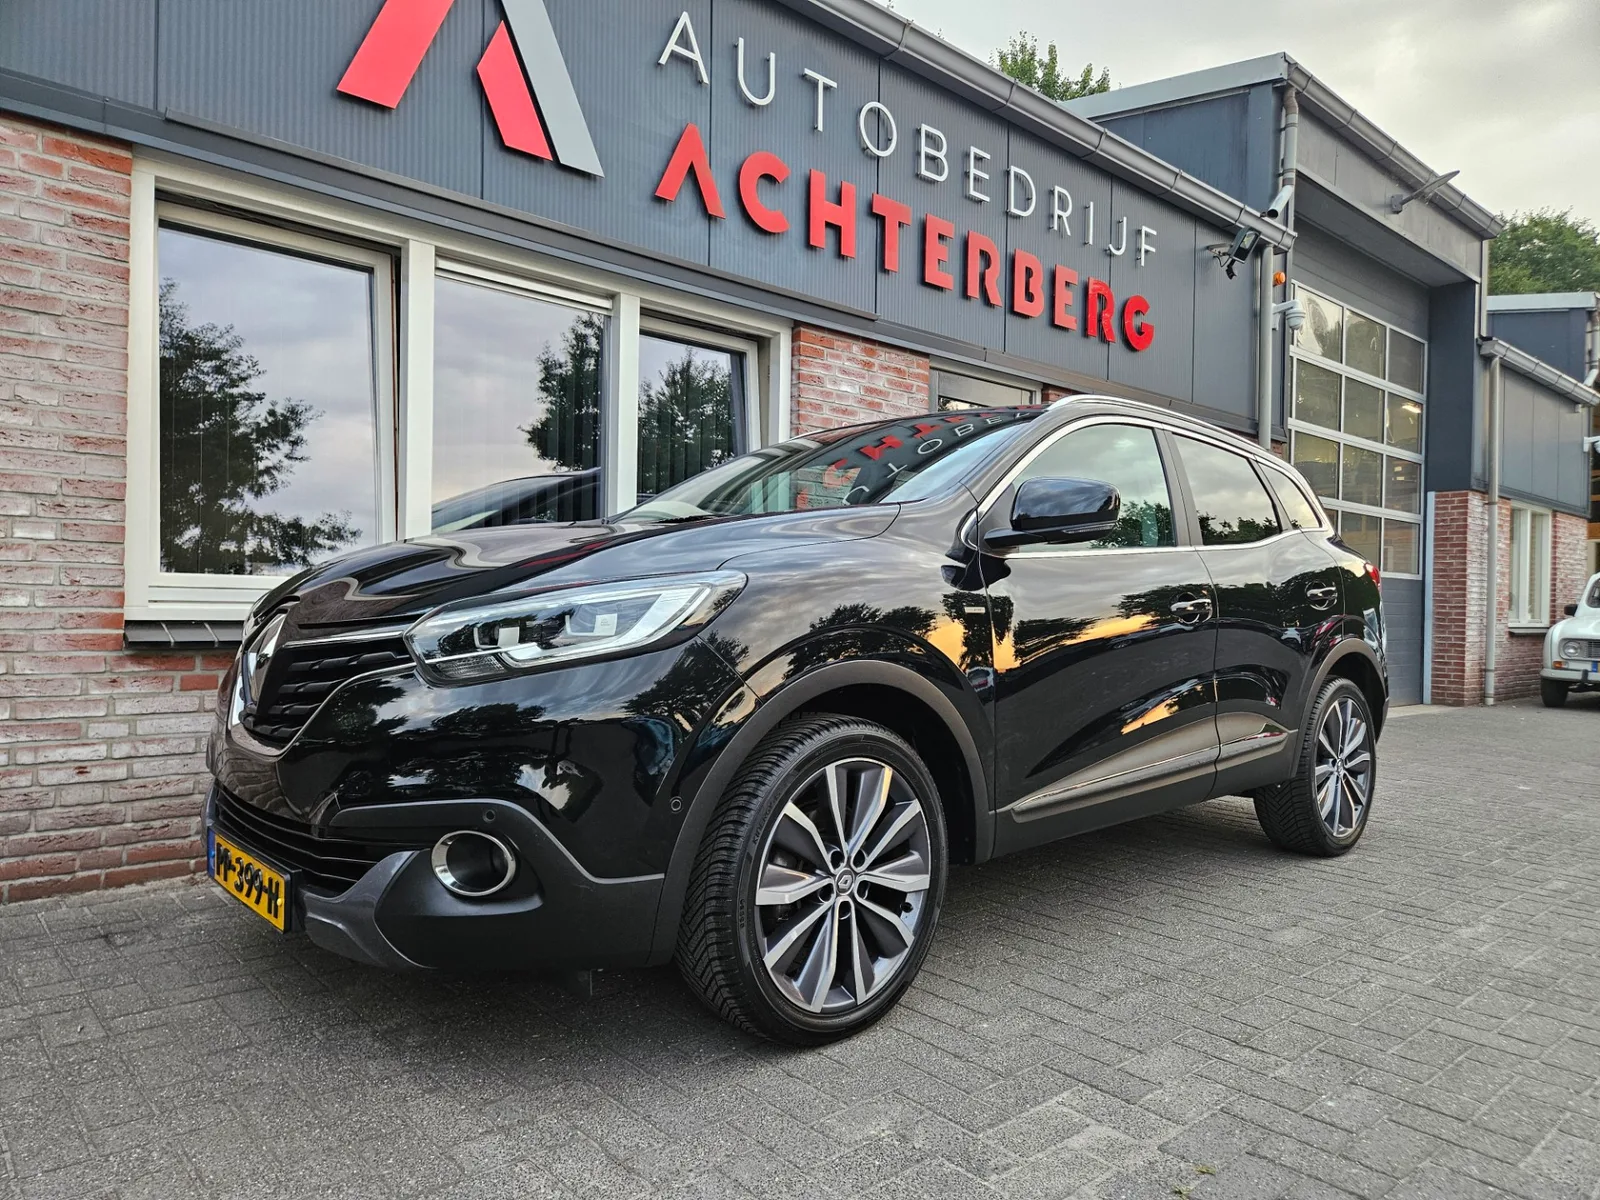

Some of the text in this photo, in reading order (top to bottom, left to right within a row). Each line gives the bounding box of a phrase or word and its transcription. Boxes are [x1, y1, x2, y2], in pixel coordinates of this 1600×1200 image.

[654, 122, 1155, 352] ACHTERBERG
[657, 11, 1158, 267] AUTOBEDRIJF
[216, 842, 280, 919] PP-399-H
